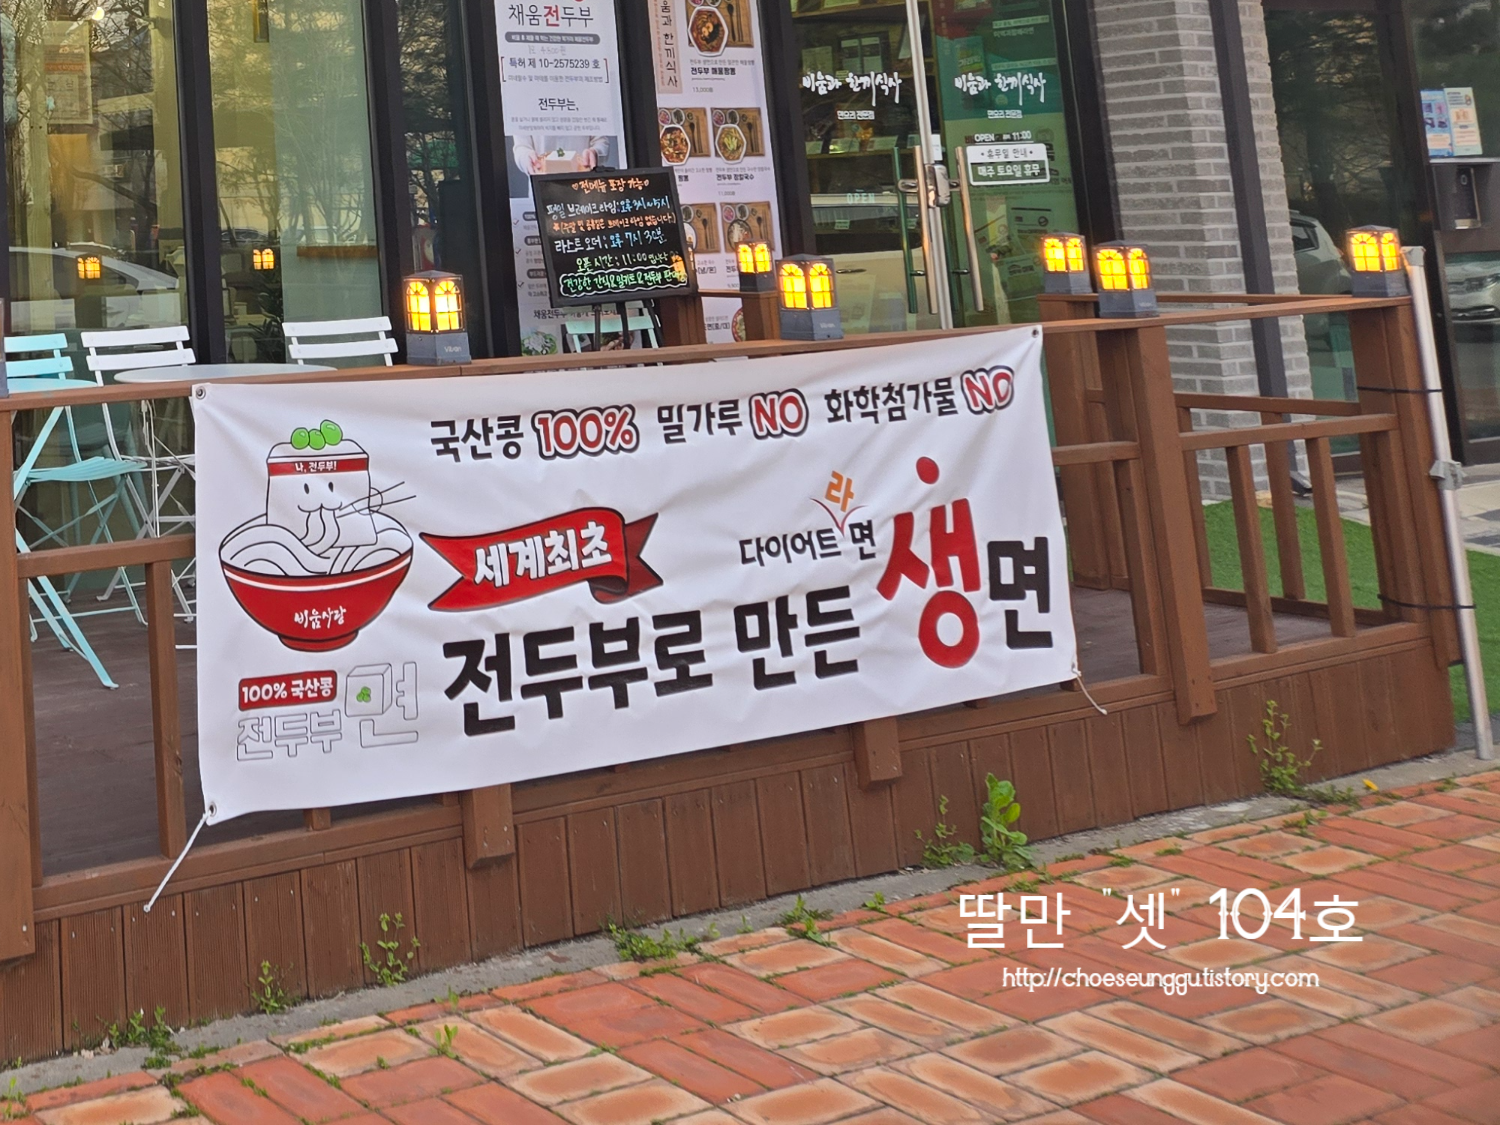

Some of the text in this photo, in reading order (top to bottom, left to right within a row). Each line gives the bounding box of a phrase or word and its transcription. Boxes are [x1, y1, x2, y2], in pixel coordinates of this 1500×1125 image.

[508, 3, 594, 28] 채움전두부
[509, 57, 601, 69] 특허 제 10-2575239 호
[663, 33, 678, 88] 한끼식사
[802, 70, 902, 107] 비움과 한끼식사
[954, 72, 1046, 106] 비움과 한끼식사
[538, 97, 579, 112] 전두부는,
[974, 134, 995, 142] OPEN
[1012, 131, 1032, 140] 11:00
[987, 147, 1028, 159] 휴무일 안내
[977, 163, 1040, 177] 매주 토요일 휴무
[608, 178, 626, 191] 포장
[846, 193, 875, 204] OPEN
[554, 239, 584, 254] 라스트
[429, 365, 1015, 463] 국산콩 100% 밀가루 NO 화학첨가물 NO
[309, 461, 337, 472] 전두부!
[824, 471, 855, 513] 라
[475, 524, 612, 588] 세계최초
[739, 528, 877, 569] 다이어트 면
[294, 606, 347, 629] 비움사랑
[442, 610, 714, 738] 전두부로
[735, 586, 861, 689] 만든
[242, 677, 333, 703] 100% 국산콩
